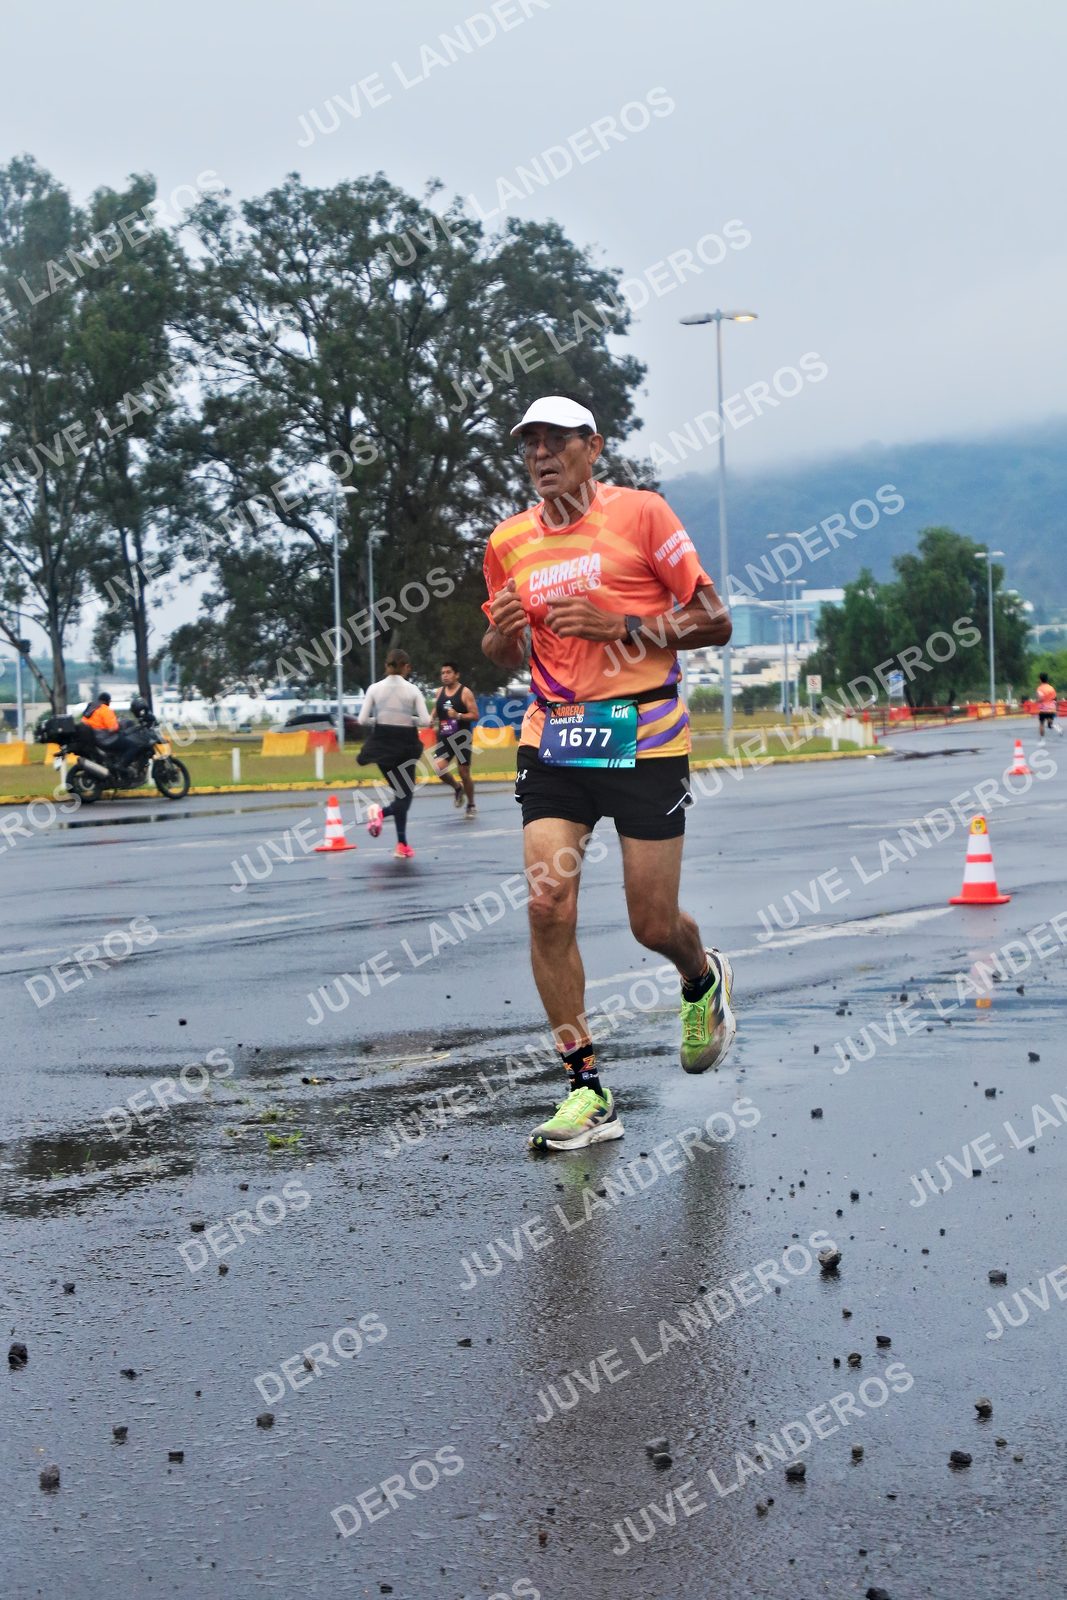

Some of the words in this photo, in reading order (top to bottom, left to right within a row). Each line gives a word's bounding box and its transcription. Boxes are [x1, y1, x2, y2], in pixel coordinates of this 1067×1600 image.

[529, 552, 601, 592] CARRERA
[529, 579, 585, 607] OMNILIFE
[611, 704, 630, 719] 10K
[558, 727, 612, 748] 1677
